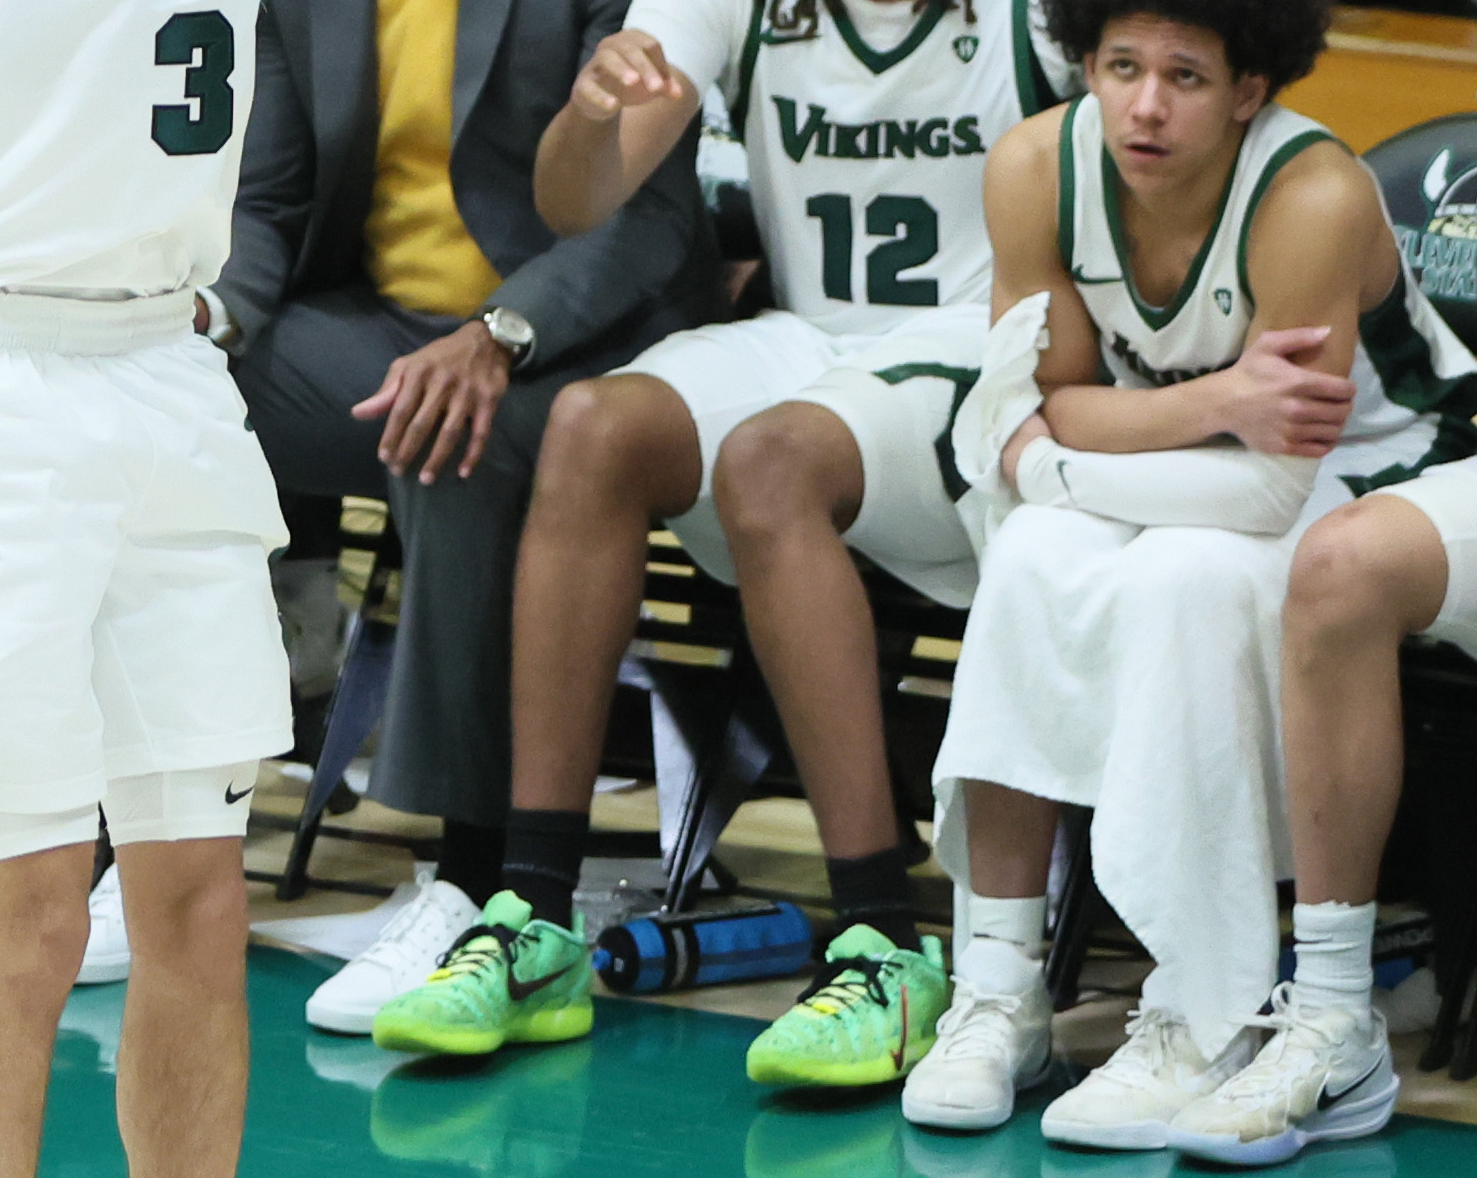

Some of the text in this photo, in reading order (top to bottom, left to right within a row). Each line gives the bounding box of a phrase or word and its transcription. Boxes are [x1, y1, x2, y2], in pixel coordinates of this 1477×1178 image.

[151, 10, 234, 156] 3
[771, 95, 985, 163] VIKINGS
[806, 193, 938, 307] 12
